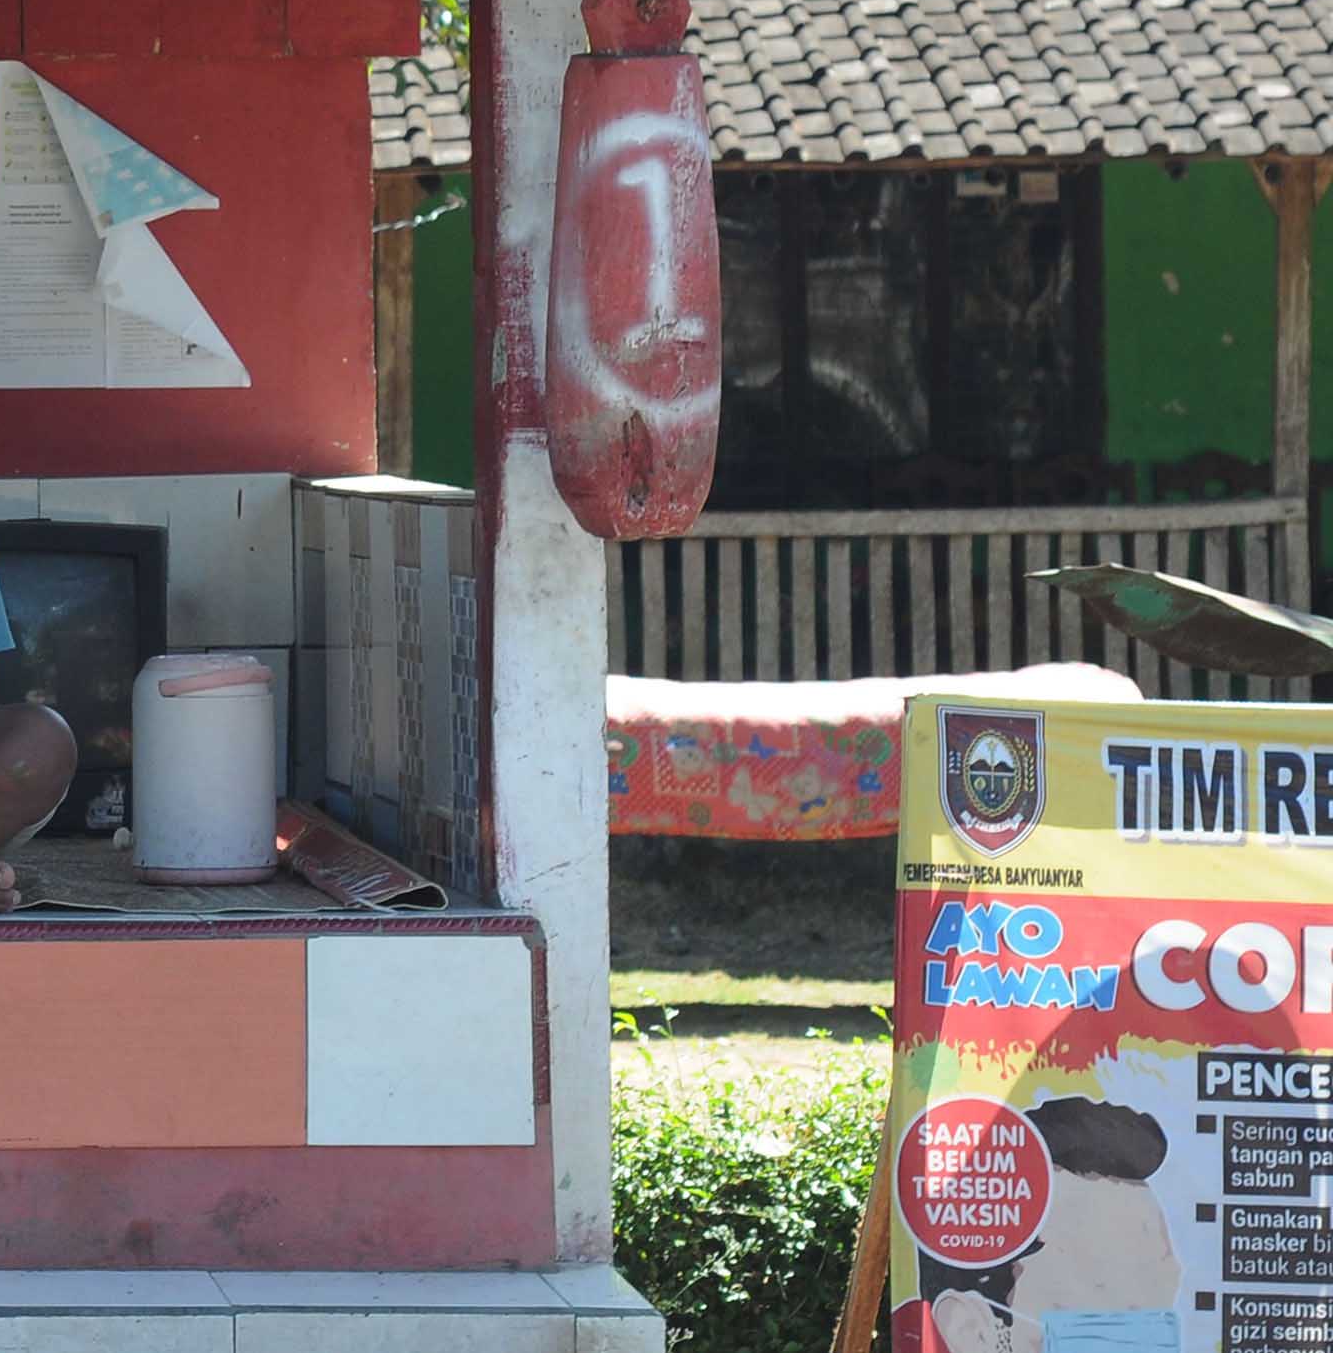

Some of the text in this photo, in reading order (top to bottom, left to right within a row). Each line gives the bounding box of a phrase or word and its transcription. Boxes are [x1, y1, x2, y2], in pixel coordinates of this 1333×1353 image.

[1104, 741, 1239, 838] TIM
[974, 865, 1002, 886] DESA
[1005, 867, 1084, 888] BANYUANYAR
[925, 900, 1064, 959] AYO
[924, 960, 1121, 1012] LAWAN
[1205, 1060, 1331, 1099] PENCE
[918, 1123, 1025, 1147] SAAT INI
[1231, 1120, 1298, 1146] Sering
[927, 1150, 1016, 1173] BELUM
[1230, 1144, 1303, 1169] tangan
[912, 1176, 1031, 1200] TERSEDIA
[1230, 1166, 1295, 1188] sabun
[924, 1202, 1021, 1227] VAKSIN
[1230, 1208, 1323, 1230] Gunakan
[939, 1234, 1006, 1248] COVID-19
[1230, 1231, 1308, 1253] masker
[1230, 1254, 1290, 1276] batuk
[1230, 1296, 1333, 1319] Konsumsi
[1229, 1320, 1268, 1344] gizi
